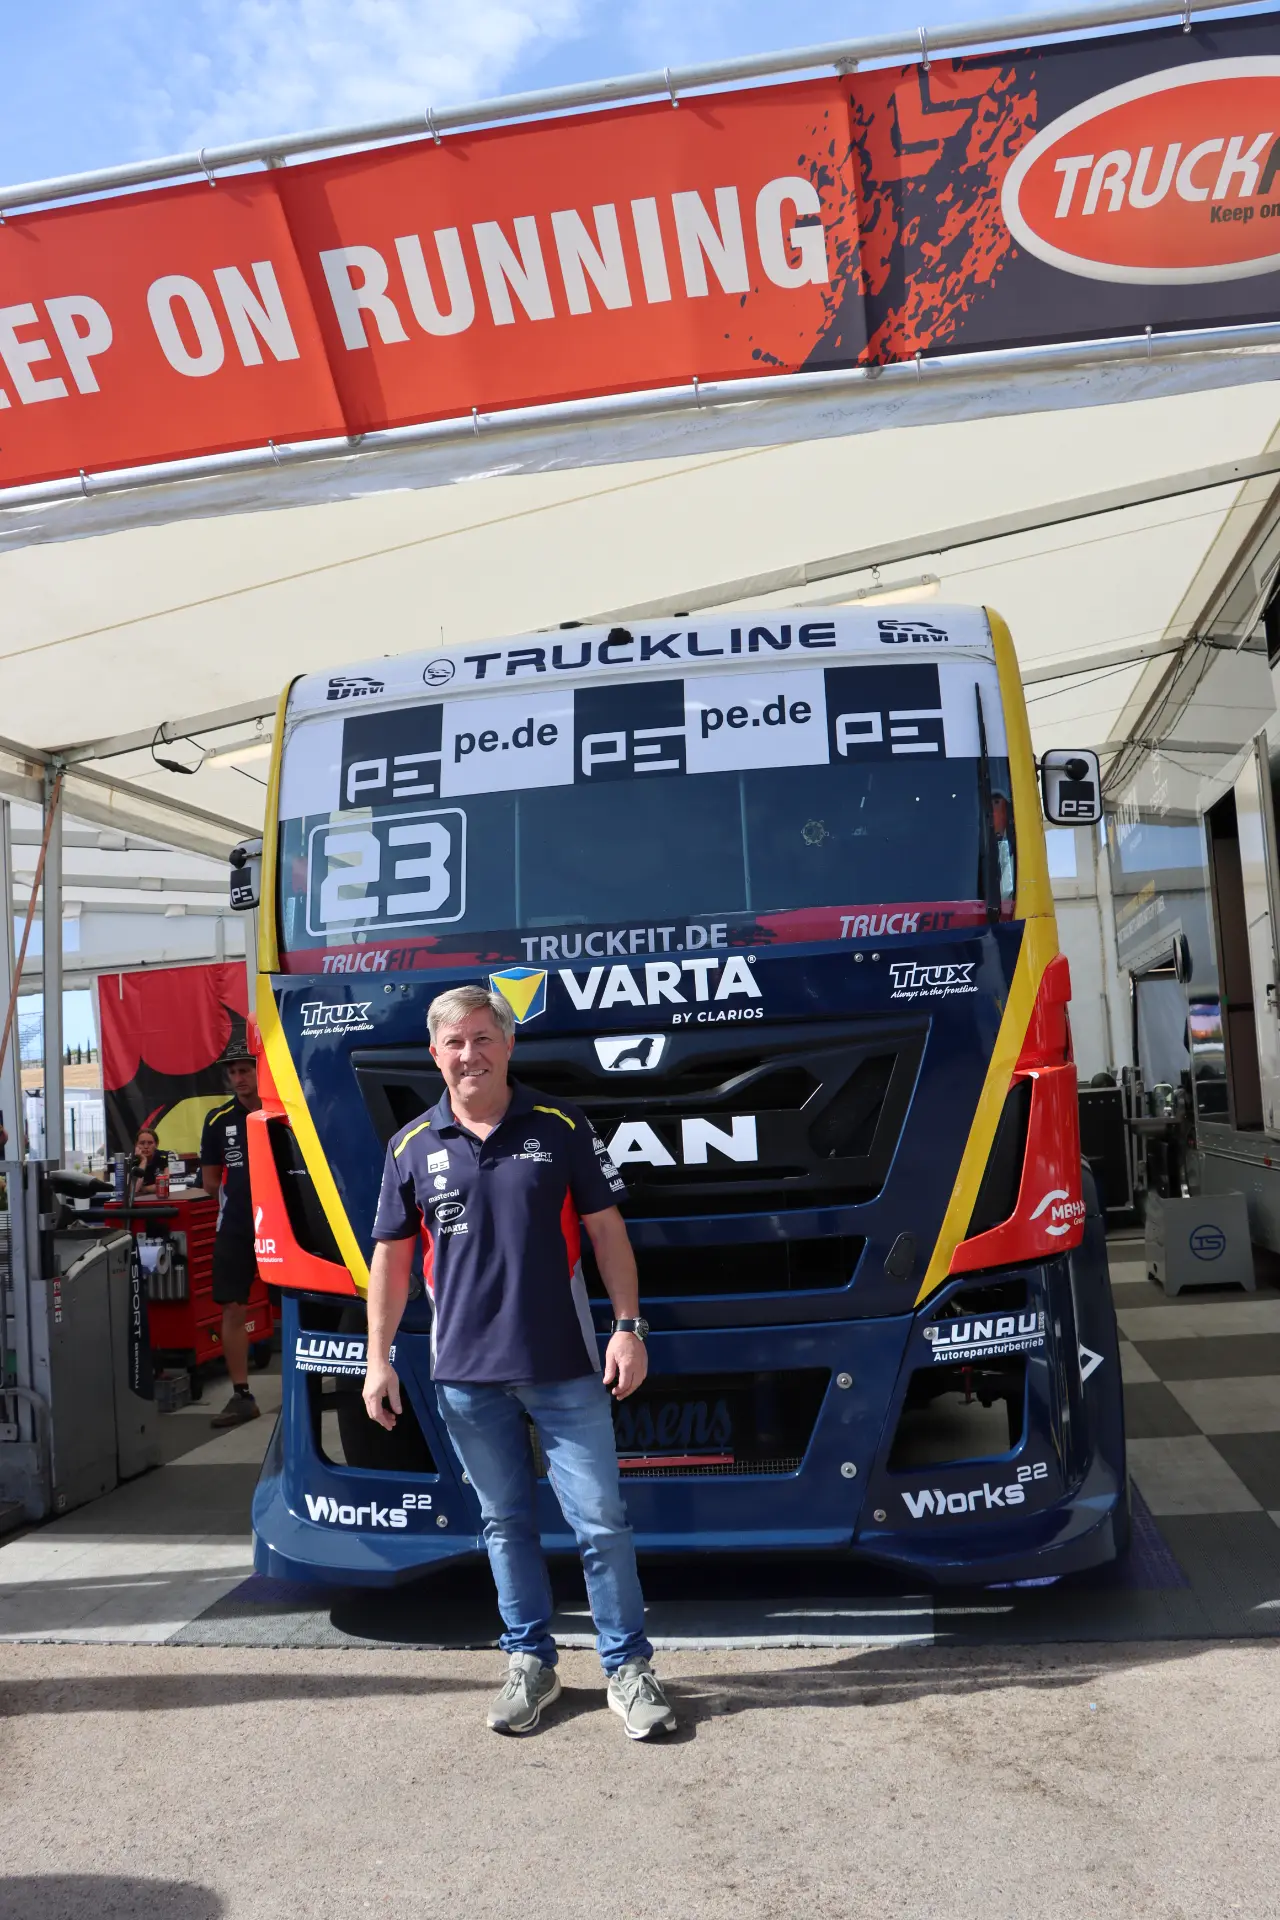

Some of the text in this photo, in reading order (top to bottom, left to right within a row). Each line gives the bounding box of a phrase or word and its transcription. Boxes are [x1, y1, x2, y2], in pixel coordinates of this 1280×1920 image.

[1209, 204, 1254, 224] Keep
[0, 175, 829, 410] EP ON RUNNING
[463, 622, 837, 680] TRUCKLINE
[700, 694, 812, 739] pe.de
[453, 717, 559, 763] pe.de
[835, 707, 944, 757] PE
[581, 725, 686, 777] PE
[346, 750, 442, 803] PE
[1061, 800, 1095, 816] PE
[319, 821, 451, 924] 23
[231, 885, 253, 903] PE
[839, 910, 956, 939] TRUCKFIT
[520, 923, 728, 962] TRUCKFIT.DE
[322, 948, 418, 974] TRUCKFIT
[889, 961, 976, 989] Trux
[890, 984, 979, 1002] Always in the frontline
[300, 1001, 373, 1027] Trux
[672, 1007, 764, 1025] BY CLARIOS
[300, 1023, 374, 1038] Always in the frontline
[519, 1151, 553, 1160] SPORT
[606, 1115, 759, 1168] AN
[428, 1189, 460, 1203] masteroil
[130, 1264, 142, 1339] SPORT
[931, 1313, 1037, 1346] LUNAU
[295, 1338, 368, 1360] LUNA
[933, 1338, 1044, 1362] Autoreparaturbetrieb
